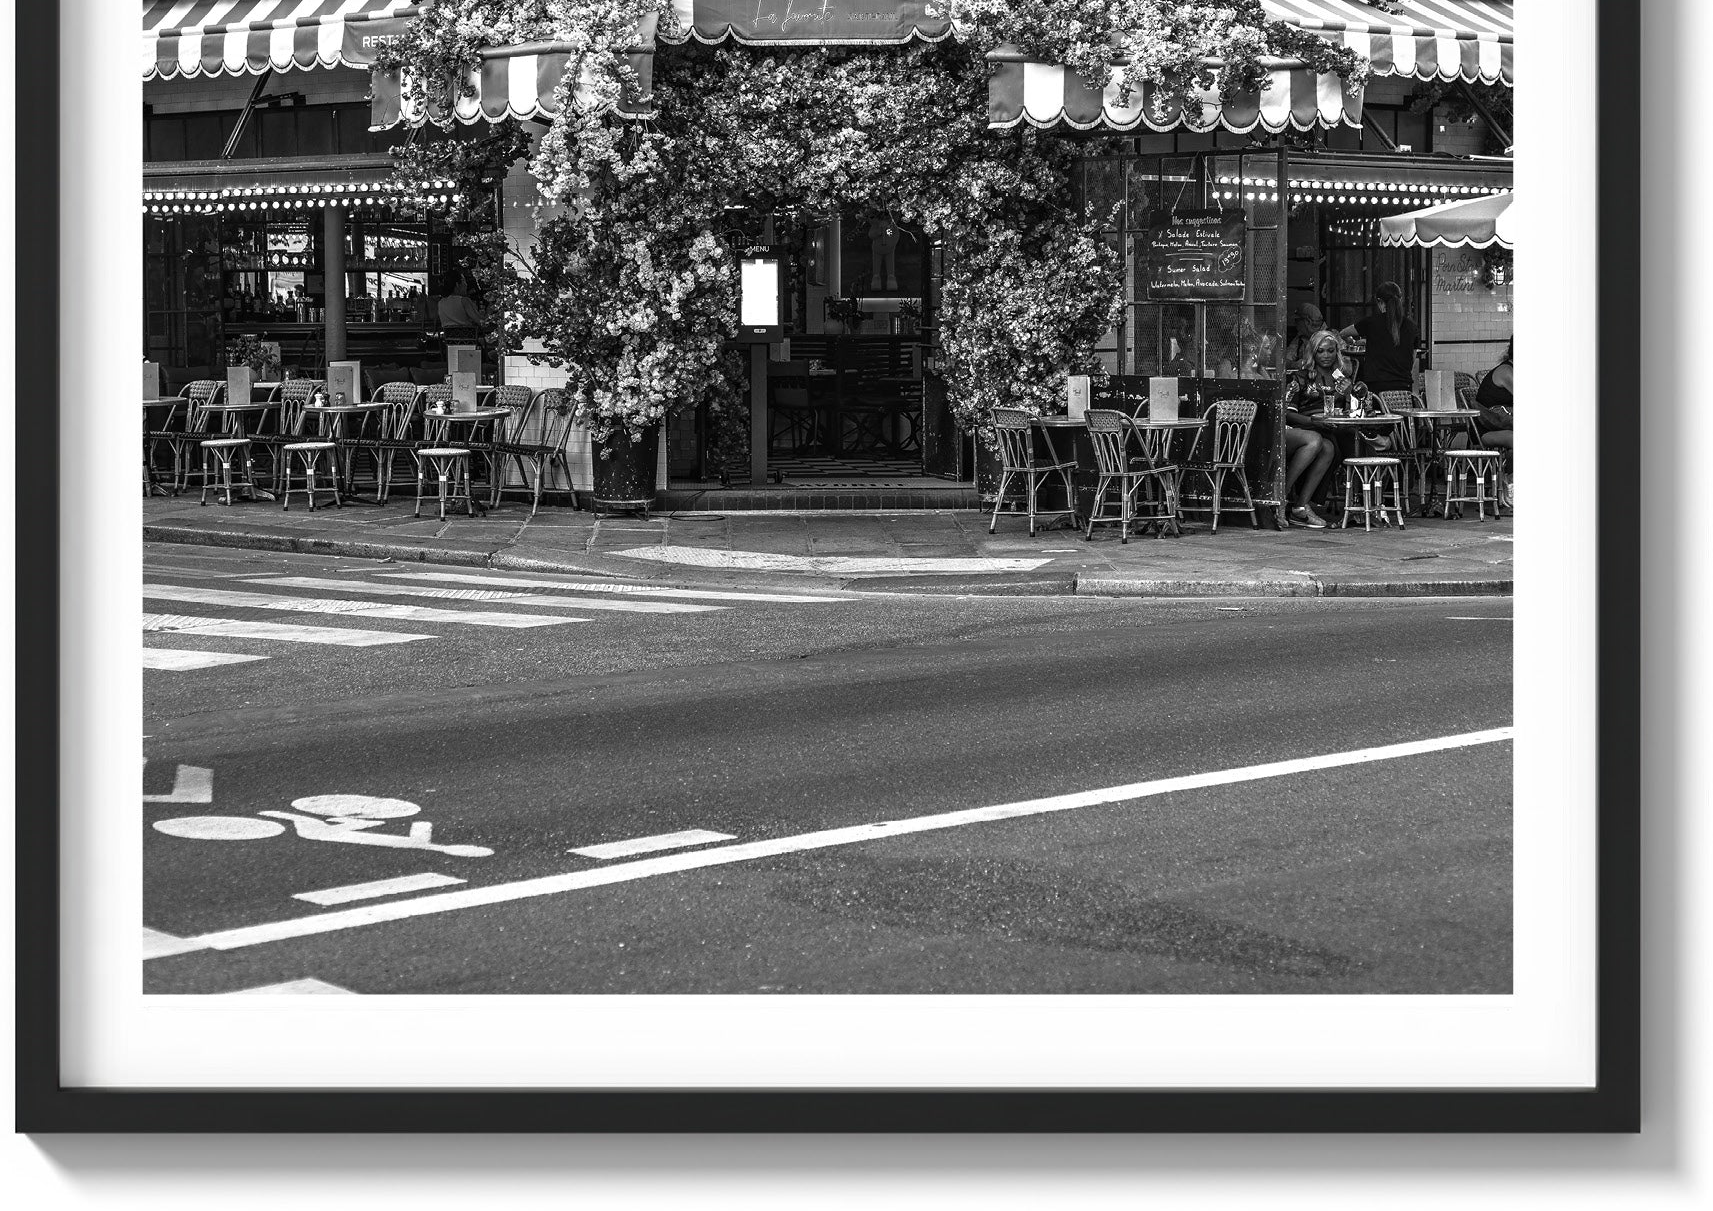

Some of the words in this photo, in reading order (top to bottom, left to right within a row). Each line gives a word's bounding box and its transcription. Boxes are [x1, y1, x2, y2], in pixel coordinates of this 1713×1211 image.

[1166, 228, 1190, 239] Salade
[1195, 229, 1221, 239] Estivale
[1191, 264, 1211, 273] Salad
[1436, 274, 1475, 292] Martini
